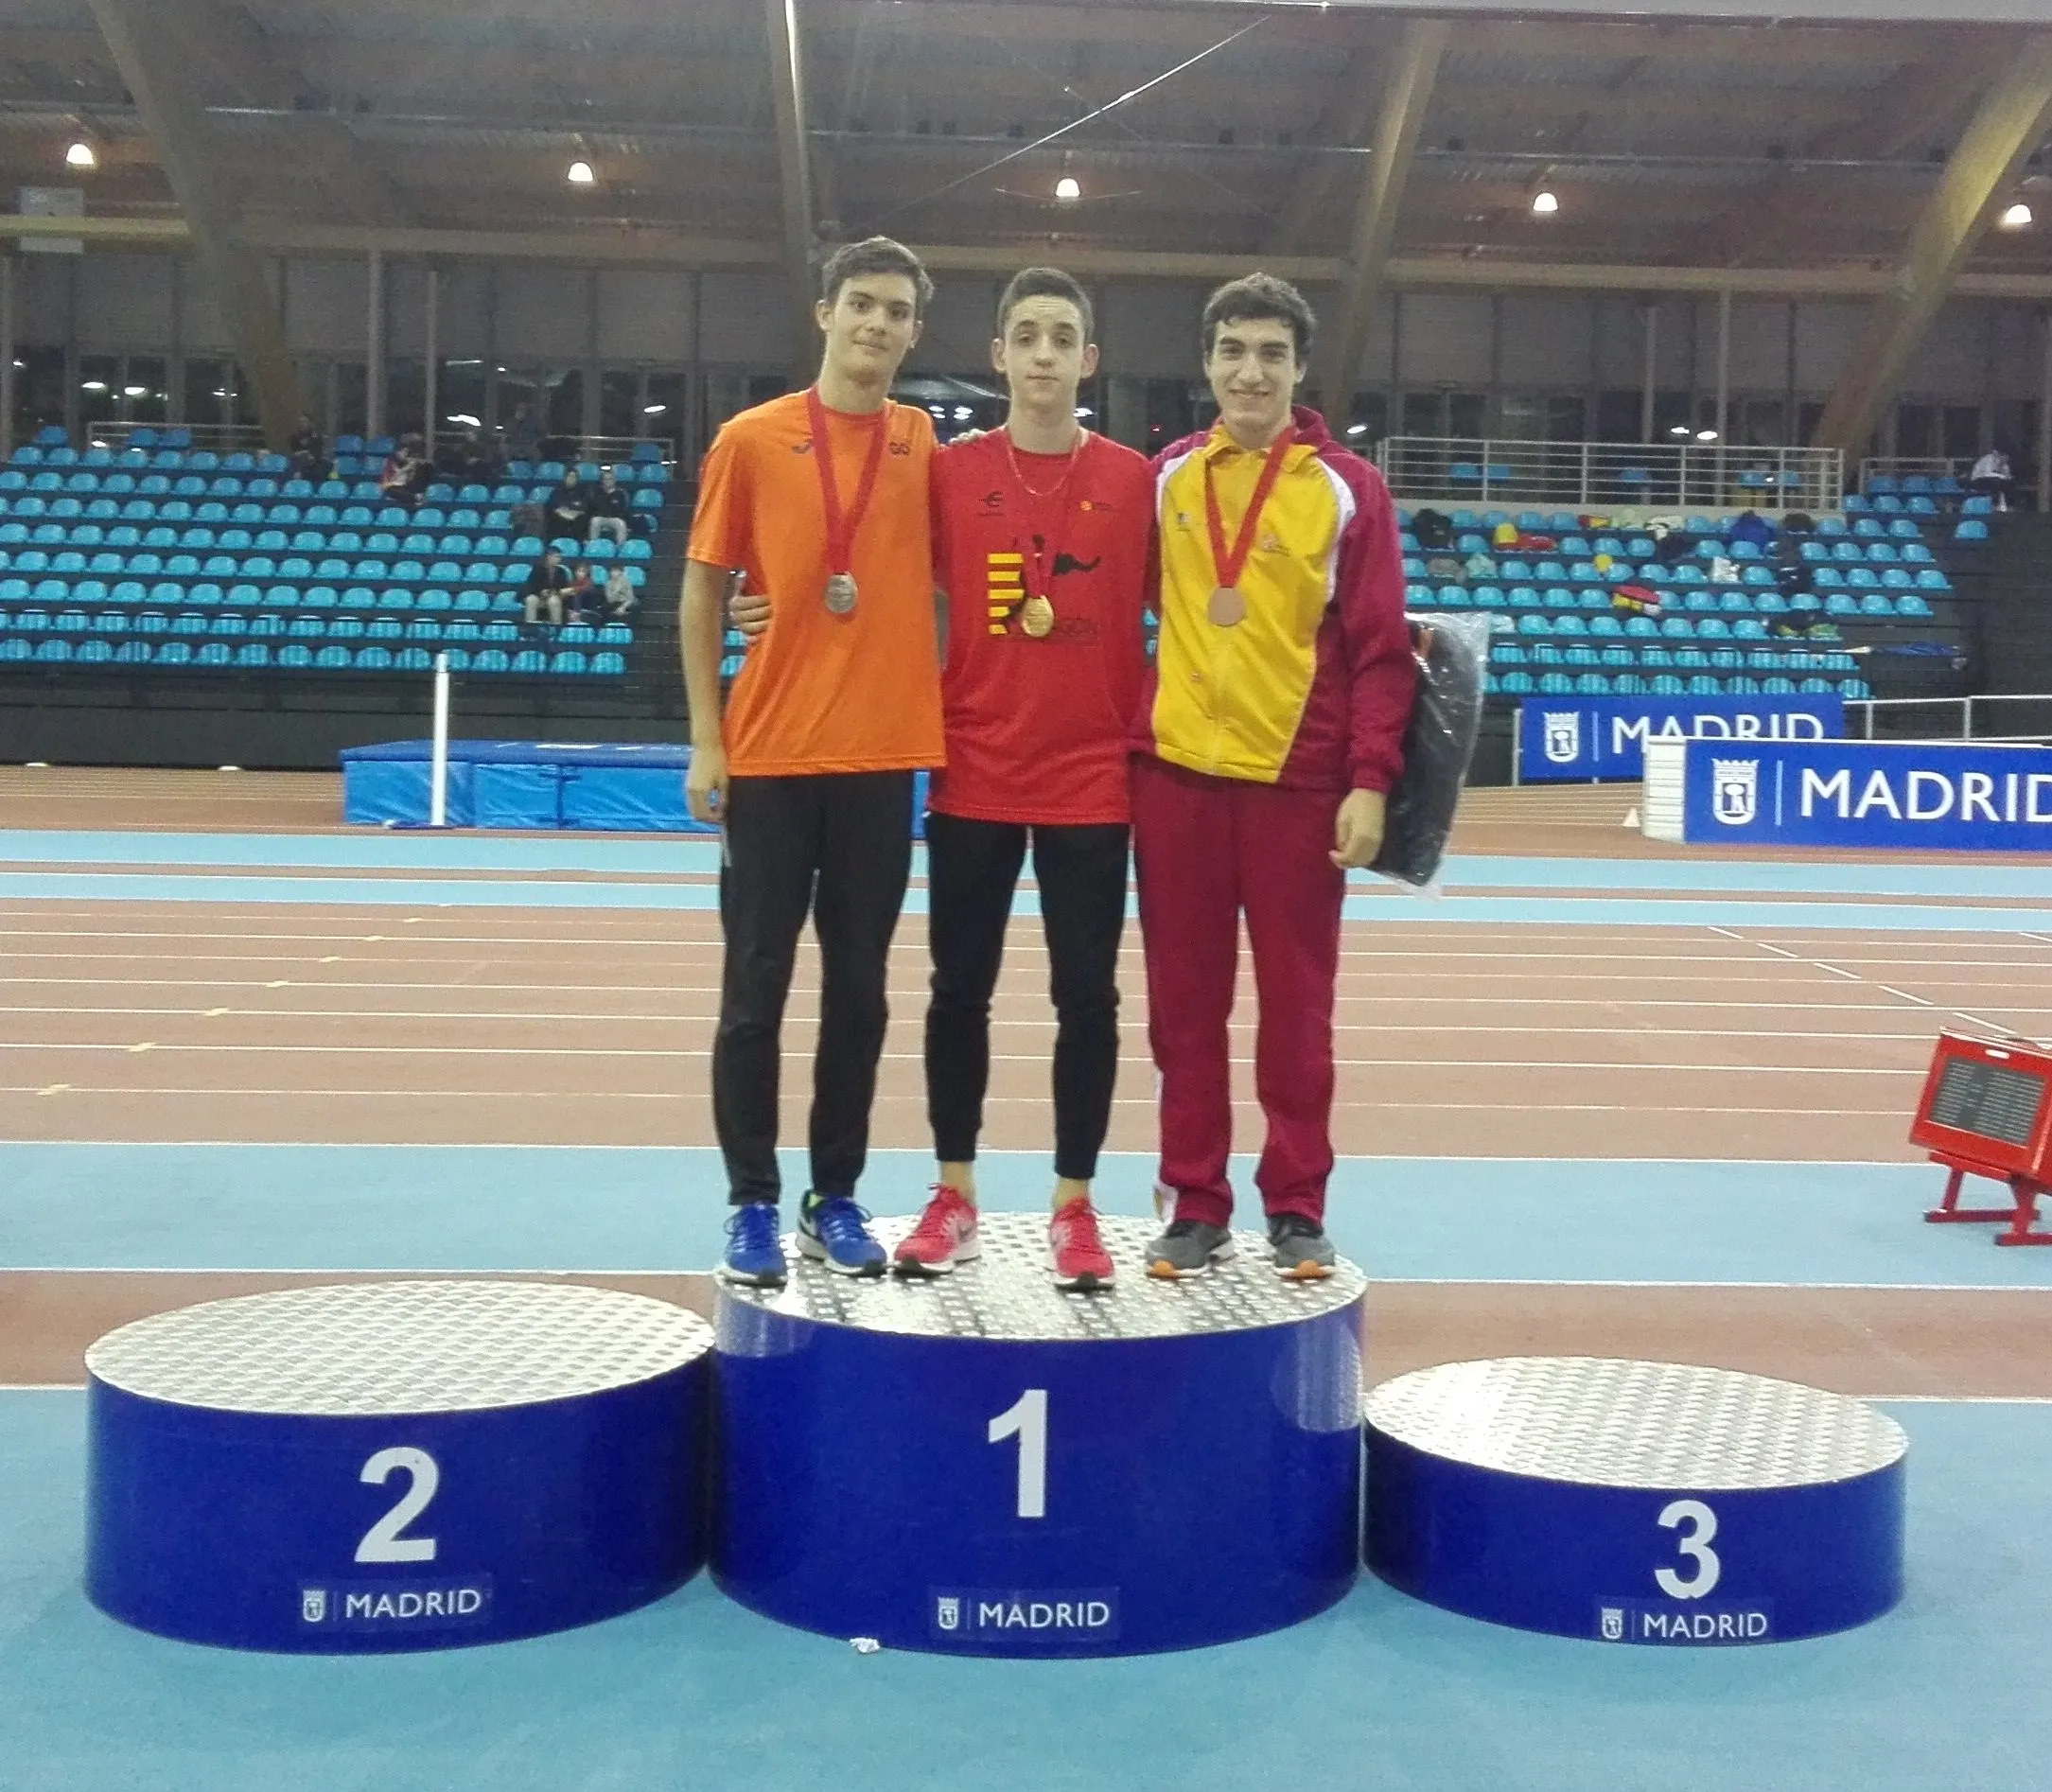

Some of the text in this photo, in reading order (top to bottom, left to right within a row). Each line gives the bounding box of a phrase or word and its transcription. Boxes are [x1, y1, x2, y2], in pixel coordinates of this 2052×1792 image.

[1800, 767, 2052, 822] MADRID
[989, 1390, 1047, 1517] 1
[355, 1447, 438, 1562] 2
[1655, 1500, 1719, 1599] 3
[347, 1590, 481, 1617] MADRID
[980, 1603, 1109, 1627] MADRID
[1644, 1613, 1766, 1638] MADRID
